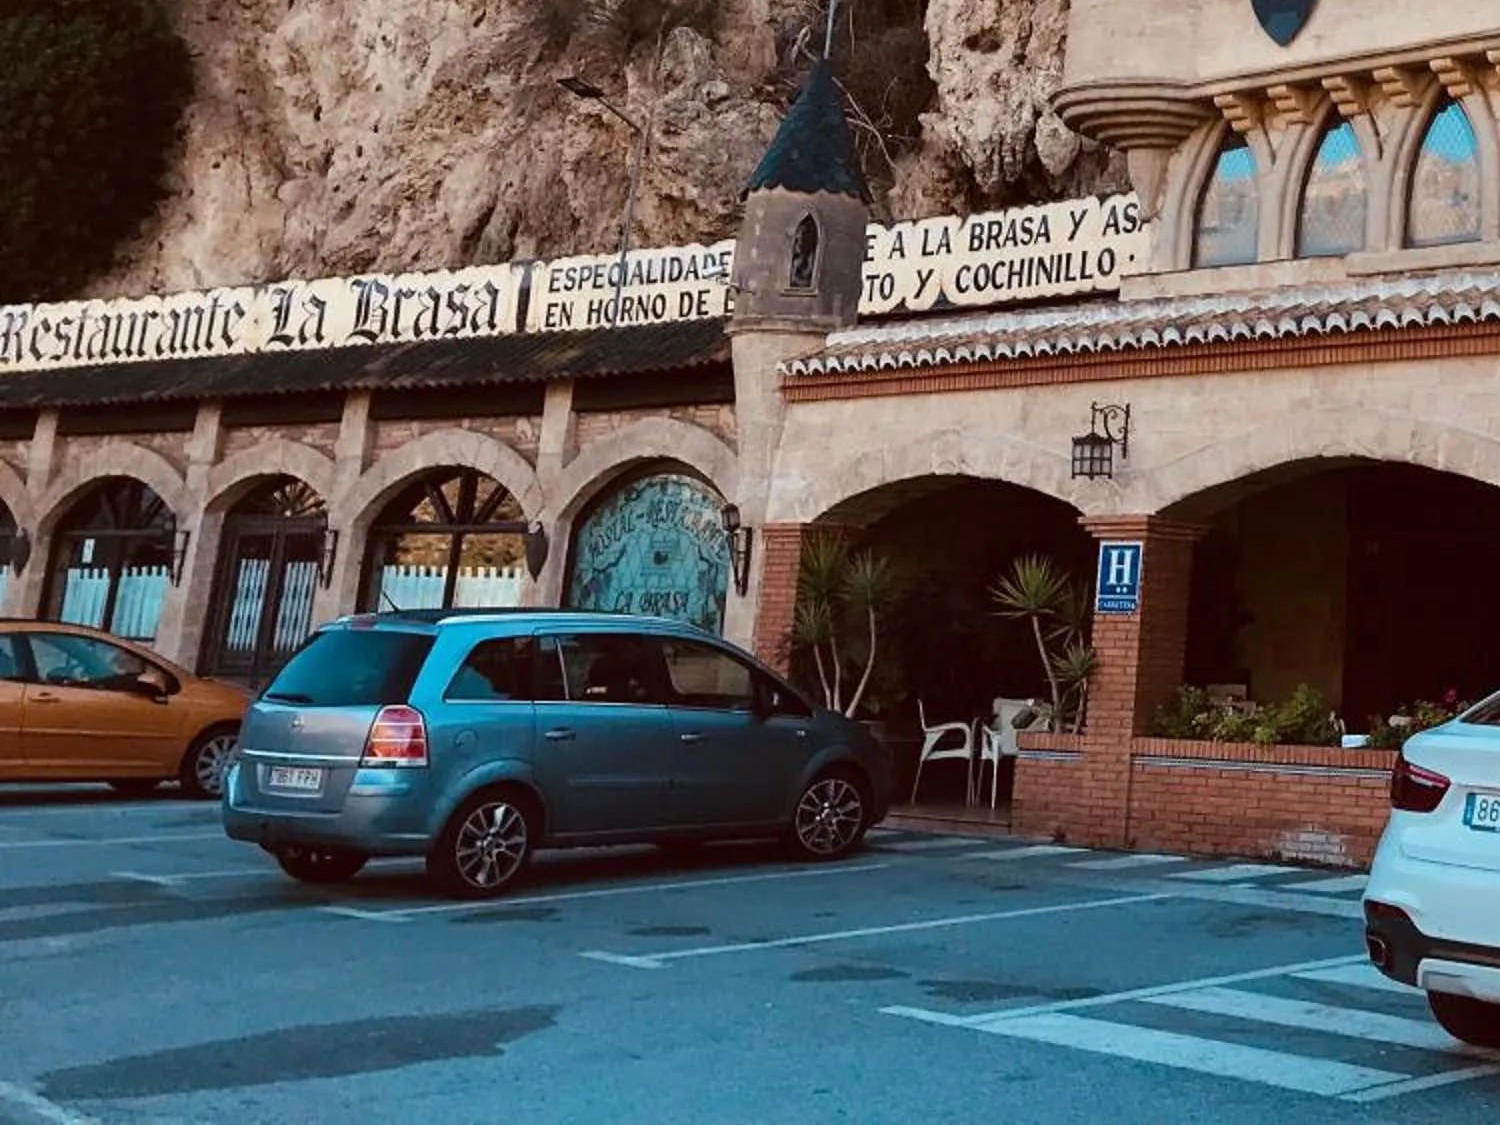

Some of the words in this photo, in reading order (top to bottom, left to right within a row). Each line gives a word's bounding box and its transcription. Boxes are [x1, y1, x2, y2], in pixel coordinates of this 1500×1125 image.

[888, 231, 905, 260] A
[921, 226, 952, 257] LA
[968, 214, 1051, 252] BRASA
[1068, 209, 1088, 241] Y
[1102, 202, 1143, 236] AS
[0, 296, 246, 363] Restaurante
[265, 287, 327, 347] La
[347, 279, 499, 343] Brasa
[545, 300, 574, 328] EN
[587, 293, 667, 325] HORNO
[678, 289, 711, 318] DE
[913, 268, 935, 300] Y
[955, 247, 1115, 294] COCHINILLO
[1106, 548, 1136, 585] H
